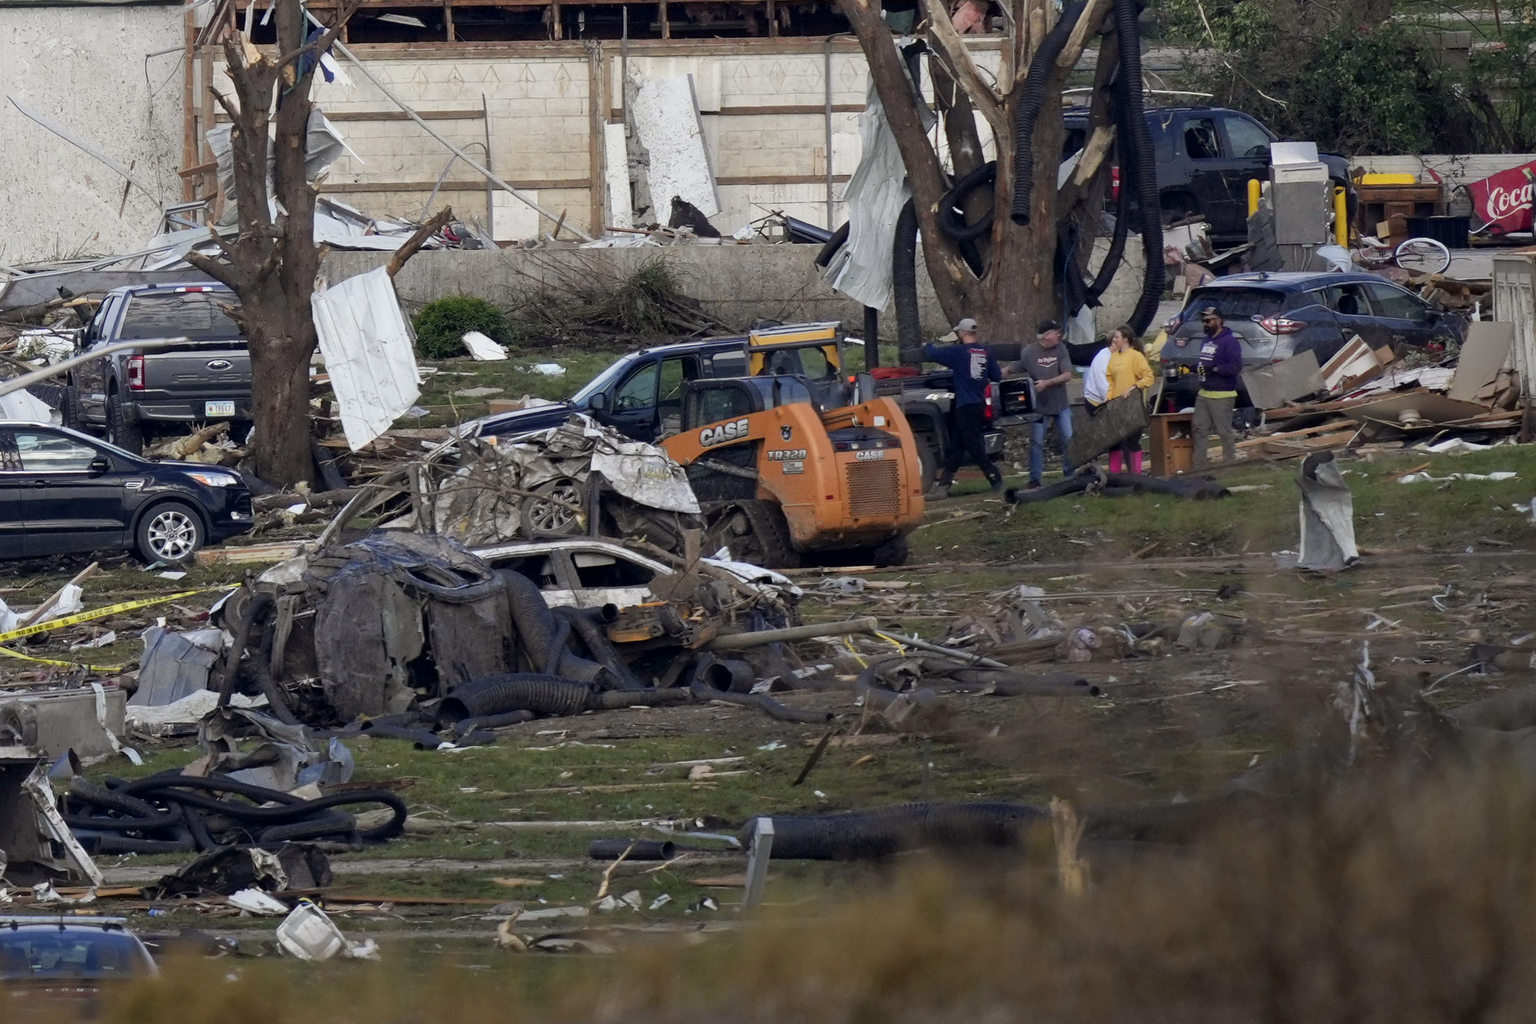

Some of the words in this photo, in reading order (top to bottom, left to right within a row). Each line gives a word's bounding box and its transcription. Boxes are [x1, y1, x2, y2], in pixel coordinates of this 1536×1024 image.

[699, 417, 749, 447] CASE
[767, 449, 807, 462] TR320
[855, 450, 885, 462] CASE
